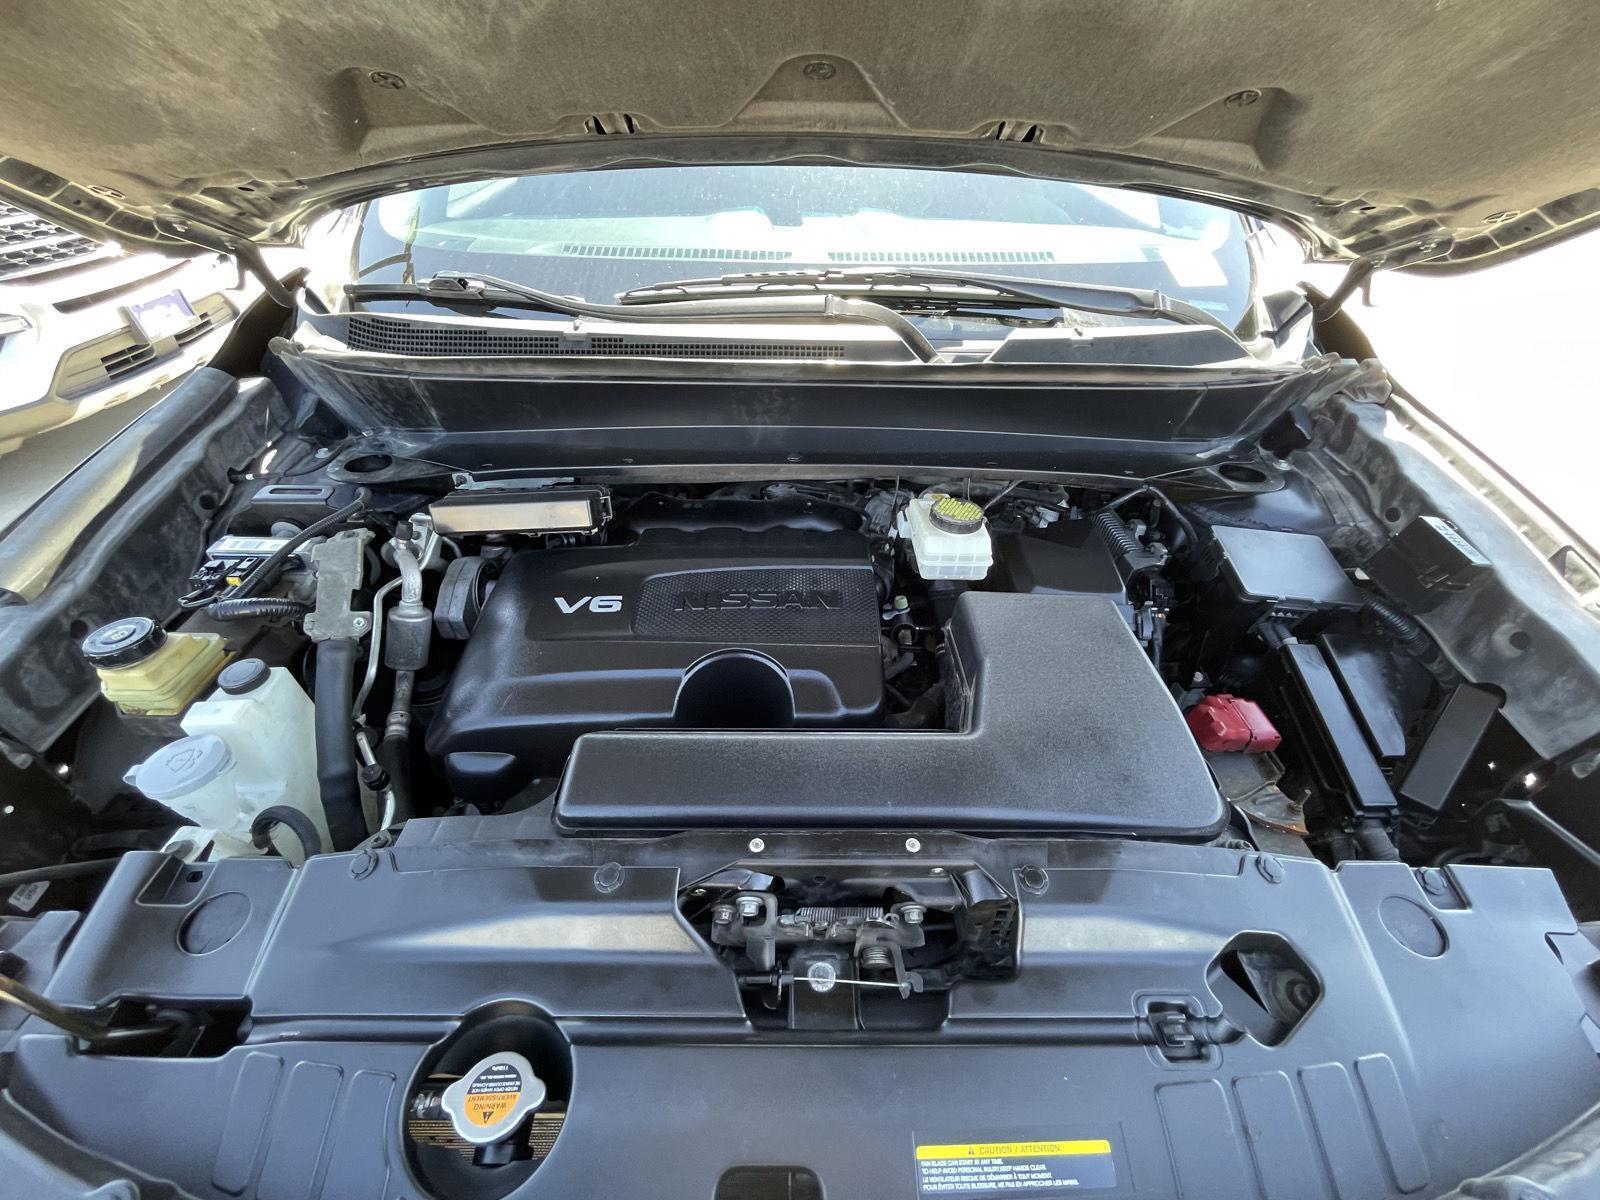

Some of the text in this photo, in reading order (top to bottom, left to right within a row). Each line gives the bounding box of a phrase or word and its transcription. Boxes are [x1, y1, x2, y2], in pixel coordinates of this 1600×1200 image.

[554, 595, 623, 614] V6
[674, 591, 841, 610] NISSAN
[467, 1094, 517, 1103] AVERTISSEMENT
[473, 1103, 507, 1111] WARNING
[980, 1145, 1012, 1154] CAUTION
[1020, 1144, 1060, 1153] ATTENTION
